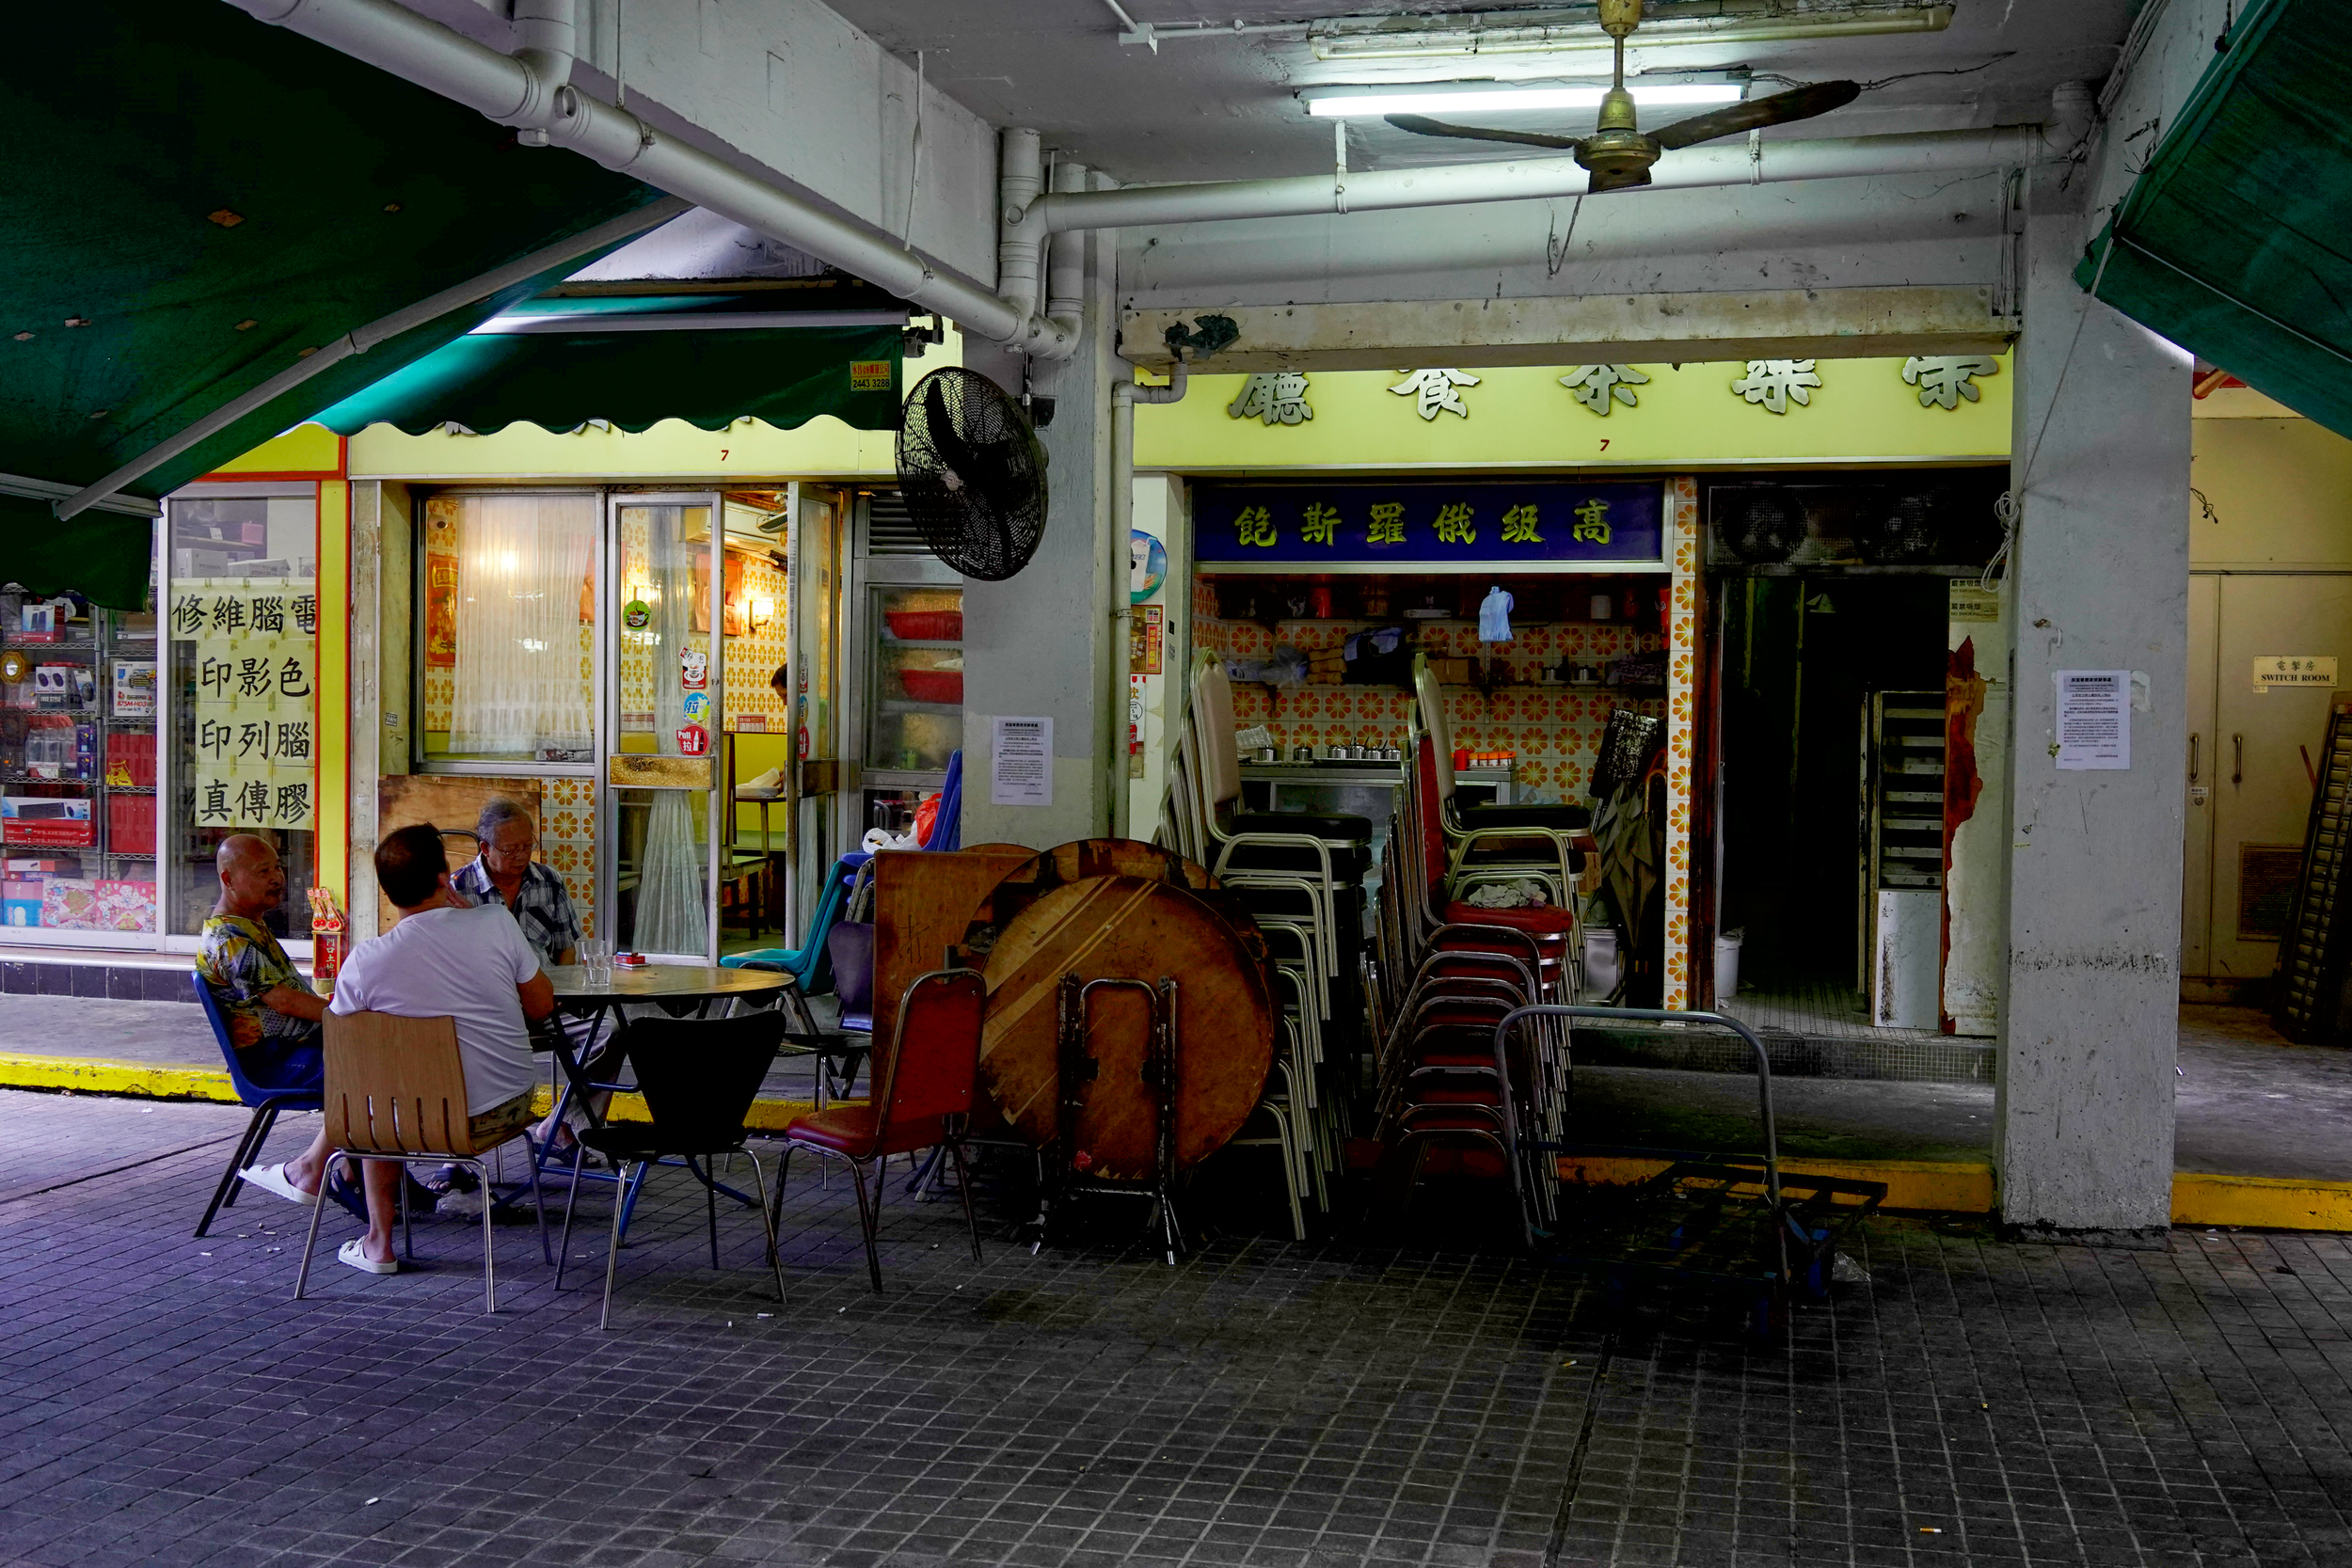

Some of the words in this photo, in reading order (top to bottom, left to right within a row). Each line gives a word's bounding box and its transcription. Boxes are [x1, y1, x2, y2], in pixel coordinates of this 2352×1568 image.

[853, 379, 870, 388] 2443
[872, 379, 890, 388] 3288
[1599, 438, 1611, 451] 7
[721, 449, 730, 462] 7
[2261, 673, 2297, 682] SWITCH
[2301, 673, 2330, 682] ROOM
[686, 701, 699, 714] 拉
[677, 730, 691, 739] Pull
[683, 741, 692, 752] 拉
